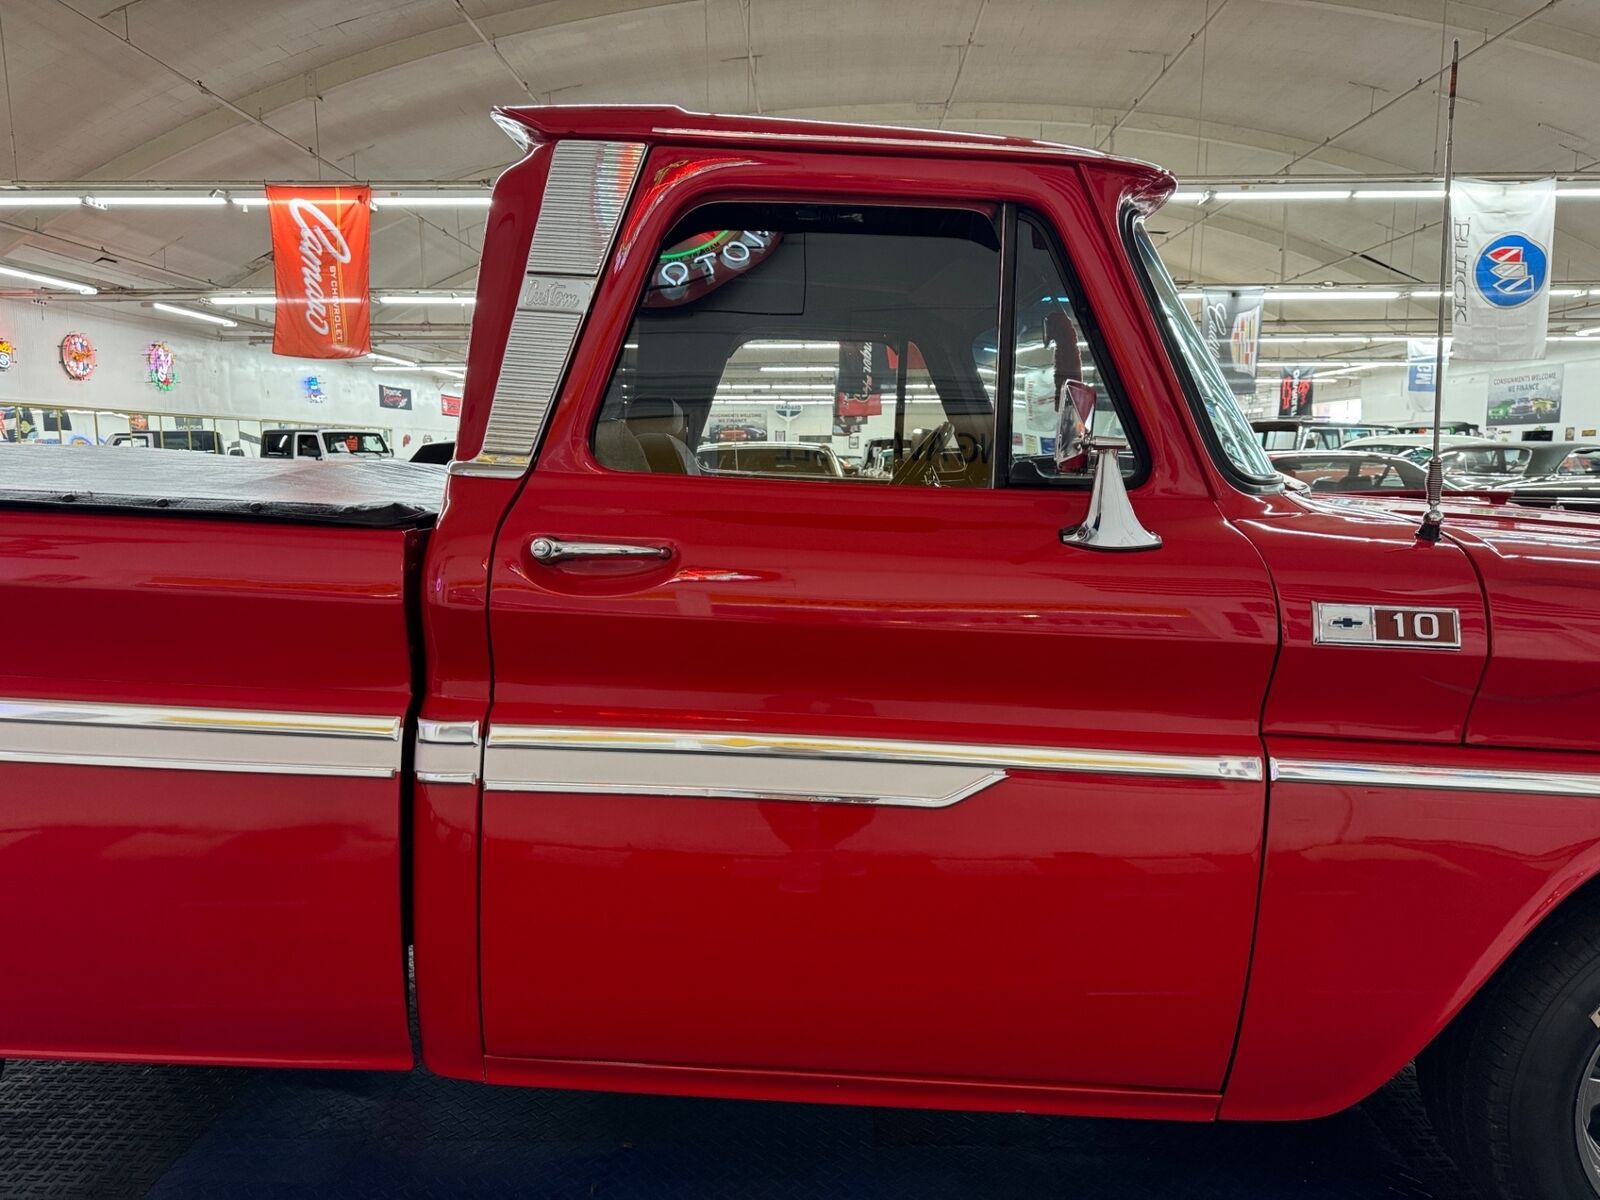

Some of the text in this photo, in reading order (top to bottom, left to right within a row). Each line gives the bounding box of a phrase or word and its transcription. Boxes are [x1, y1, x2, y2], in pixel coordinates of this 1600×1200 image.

[288, 198, 352, 336] Camaro
[329, 265, 343, 341] BY CHEVROLET
[526, 279, 580, 308] Custom
[1493, 371, 1556, 385] CONSIGNMENTS WELCOME
[1515, 382, 1539, 391] FINANCE
[1392, 612, 1440, 639] 10
